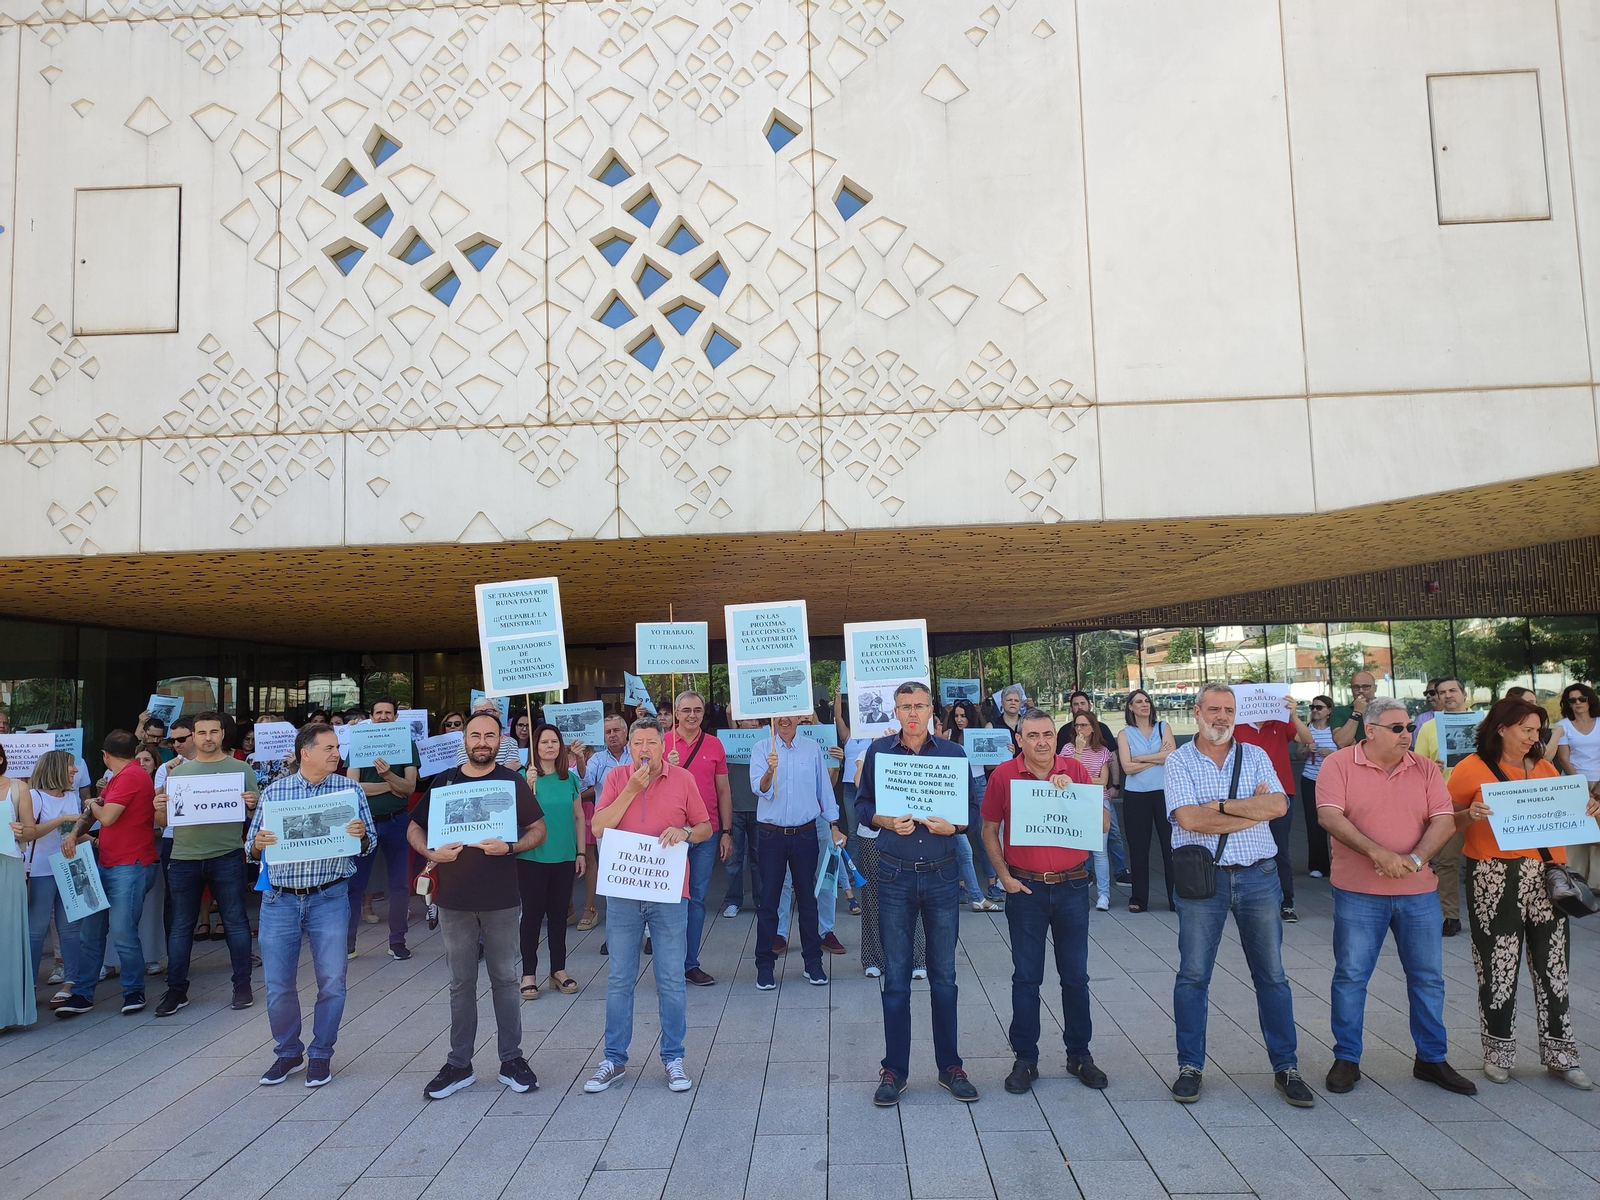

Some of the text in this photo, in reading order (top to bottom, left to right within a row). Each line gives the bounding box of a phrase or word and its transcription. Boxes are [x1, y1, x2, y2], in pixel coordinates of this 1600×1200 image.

[497, 641, 551, 651] TRABAJADORES
[511, 657, 541, 665] JUSTICIA
[498, 663, 554, 674] DISCRIMINADOS
[518, 671, 552, 679] MINISTRA
[1032, 789, 1077, 800] HUELGA
[1043, 814, 1068, 823] ¡POR
[1537, 821, 1577, 830] JUSTICIA
[1025, 825, 1082, 838] DIGNIDAD!
[638, 842, 652, 852] MI
[618, 851, 665, 866] TRABAJO
[612, 863, 669, 878] LO QUIERO
[607, 874, 670, 890] COBRAR YO.
